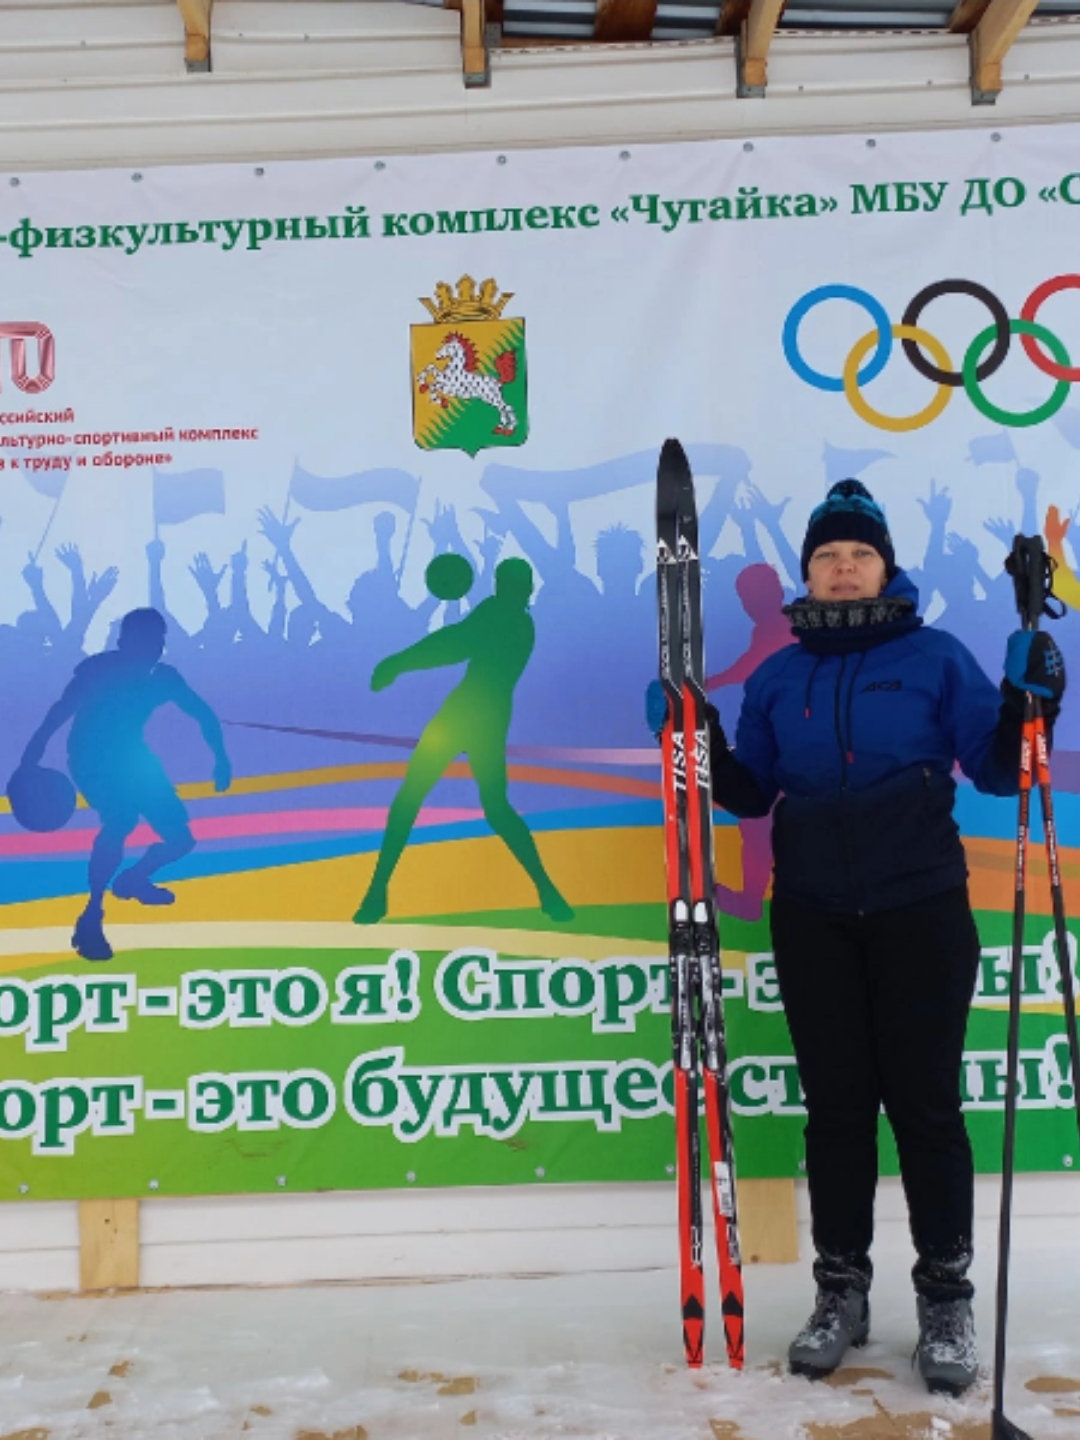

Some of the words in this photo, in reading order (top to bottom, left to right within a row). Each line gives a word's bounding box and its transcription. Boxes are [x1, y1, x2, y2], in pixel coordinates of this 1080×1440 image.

[383, 202, 599, 237] комплекс
[852, 180, 948, 215] МБУ
[960, 176, 1027, 216] ДО
[178, 427, 259, 442] комплекс
[10, 456, 20, 470] к
[22, 455, 73, 473] труду
[76, 455, 88, 467] и
[337, 956, 414, 1017] я!
